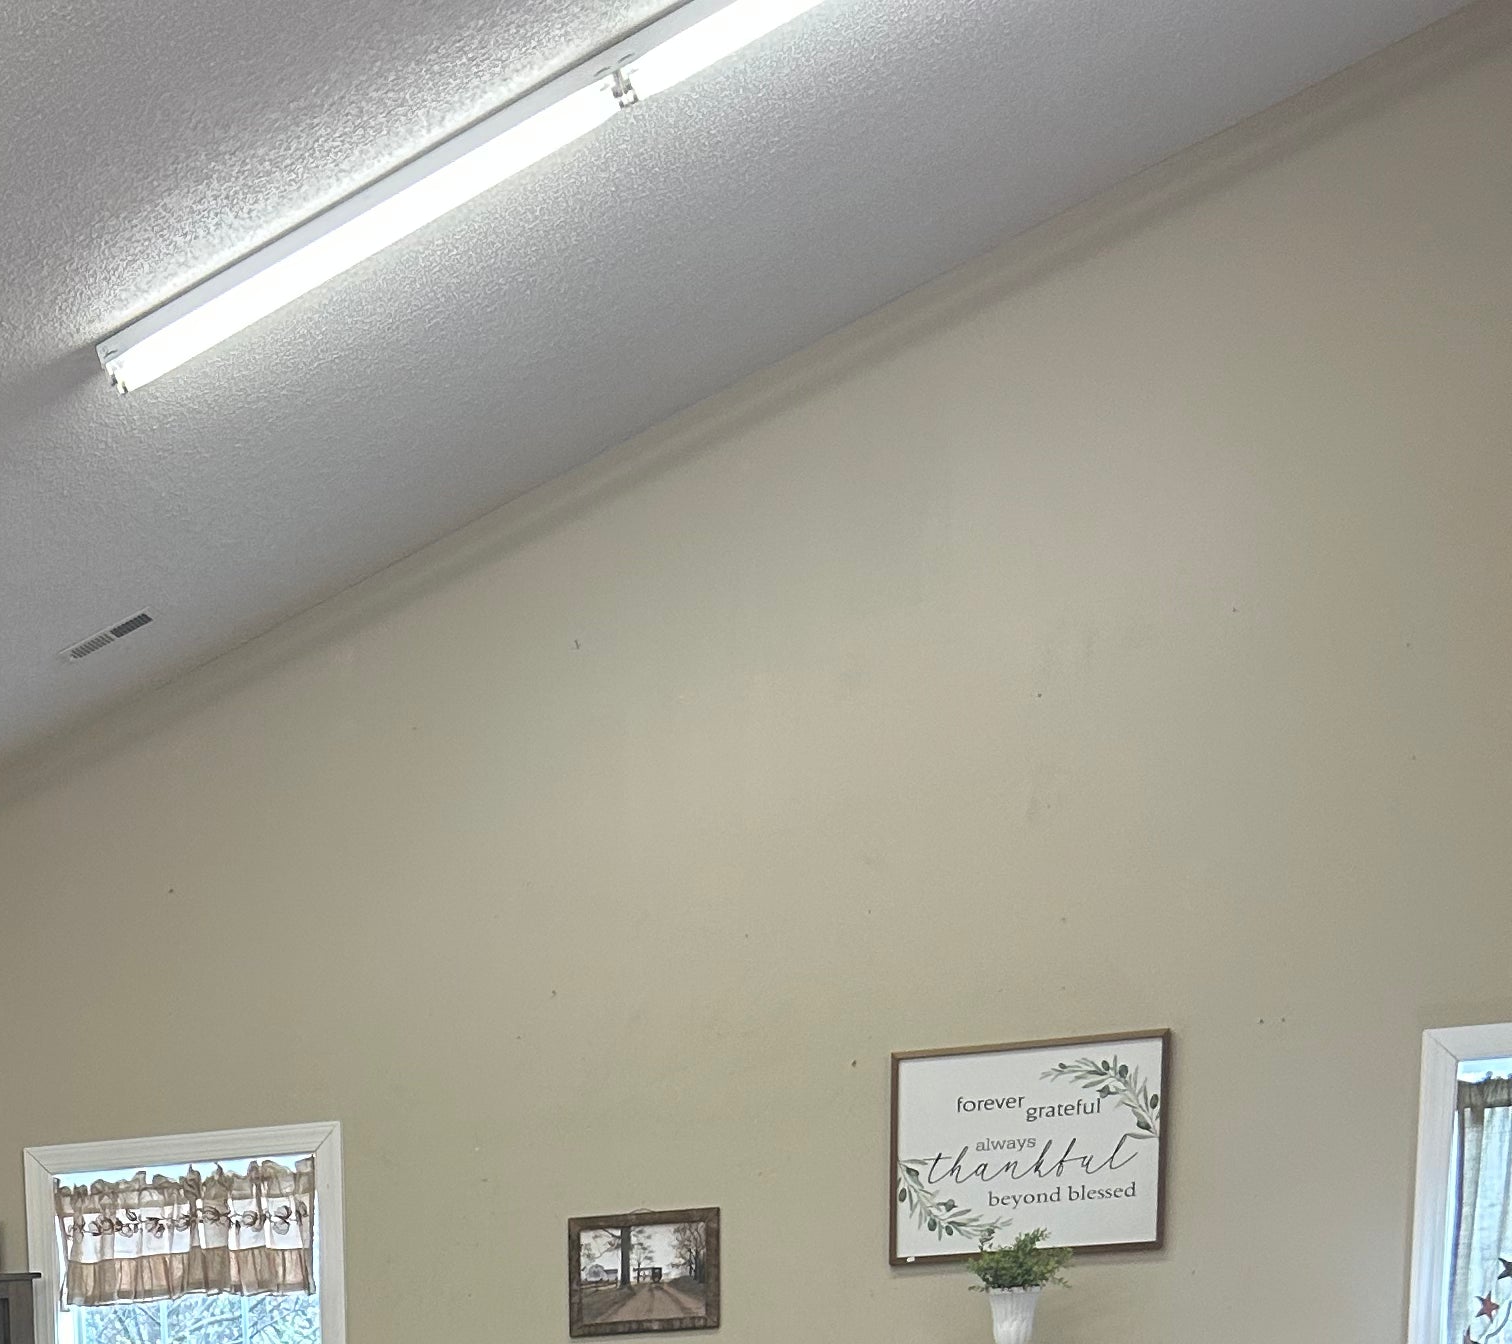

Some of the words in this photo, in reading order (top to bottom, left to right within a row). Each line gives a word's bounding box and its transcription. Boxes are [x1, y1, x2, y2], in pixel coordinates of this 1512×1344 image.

[957, 1096, 1025, 1113] forever
[1025, 1098, 1101, 1122] grateful
[975, 1136, 1037, 1152] always
[923, 1133, 1139, 1185] thankful
[988, 1187, 1061, 1210] beyond
[1068, 1181, 1136, 1202] blessed
